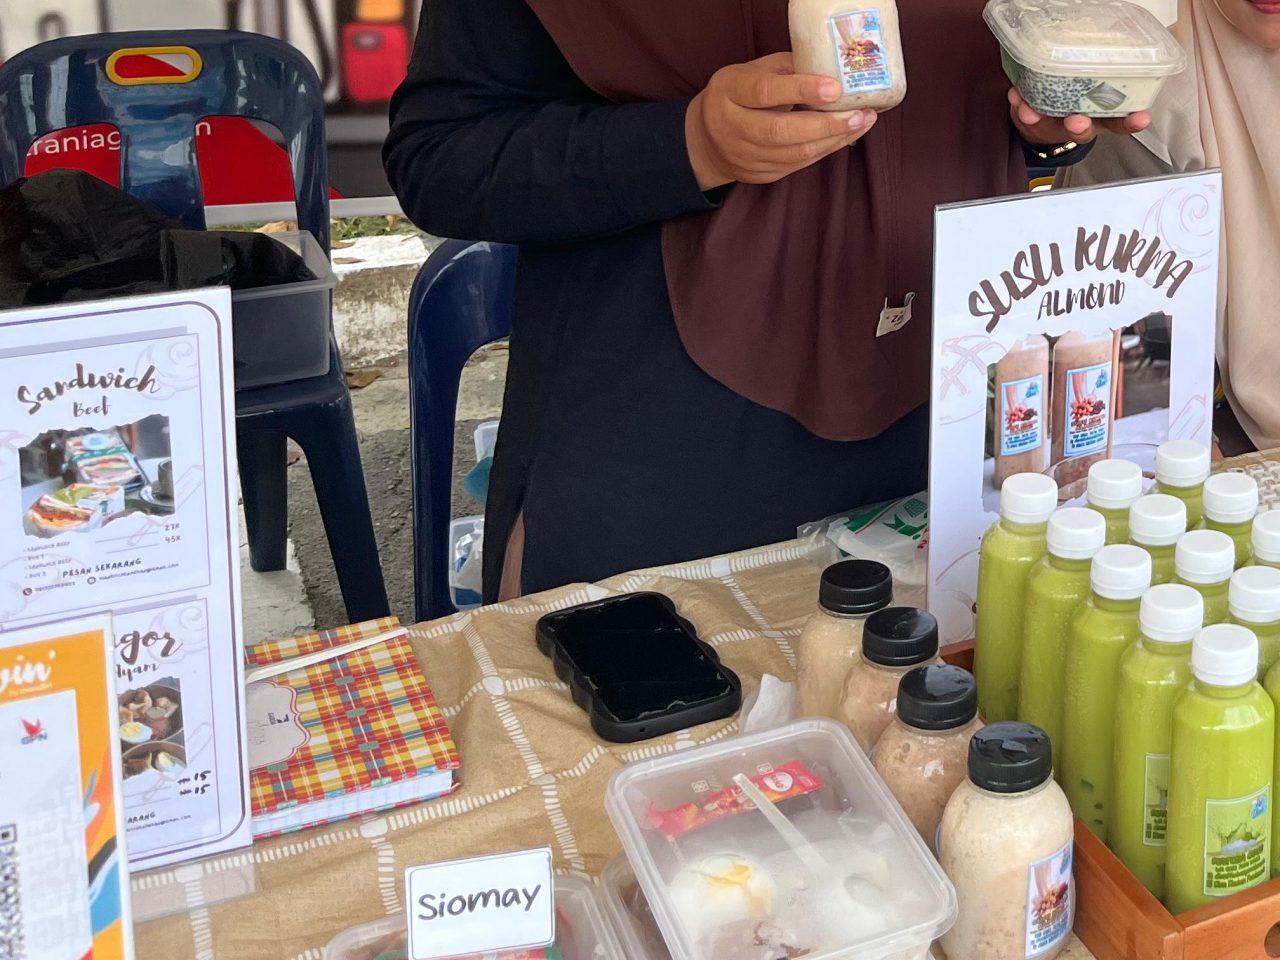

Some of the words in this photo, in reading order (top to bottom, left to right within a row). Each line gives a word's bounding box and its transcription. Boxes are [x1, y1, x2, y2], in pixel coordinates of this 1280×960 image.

[26, 129, 120, 157] raniag
[968, 242, 1064, 333] SUSU
[1074, 224, 1194, 298] KURMA
[1037, 279, 1125, 320] ALMOND
[17, 362, 161, 415] Sandwich
[72, 395, 111, 417] Beef
[61, 567, 91, 578] PESAN
[94, 557, 142, 572] SEKARANG
[113, 630, 184, 666] gor
[127, 812, 156, 825] ARANG
[418, 884, 542, 920] Siomay
